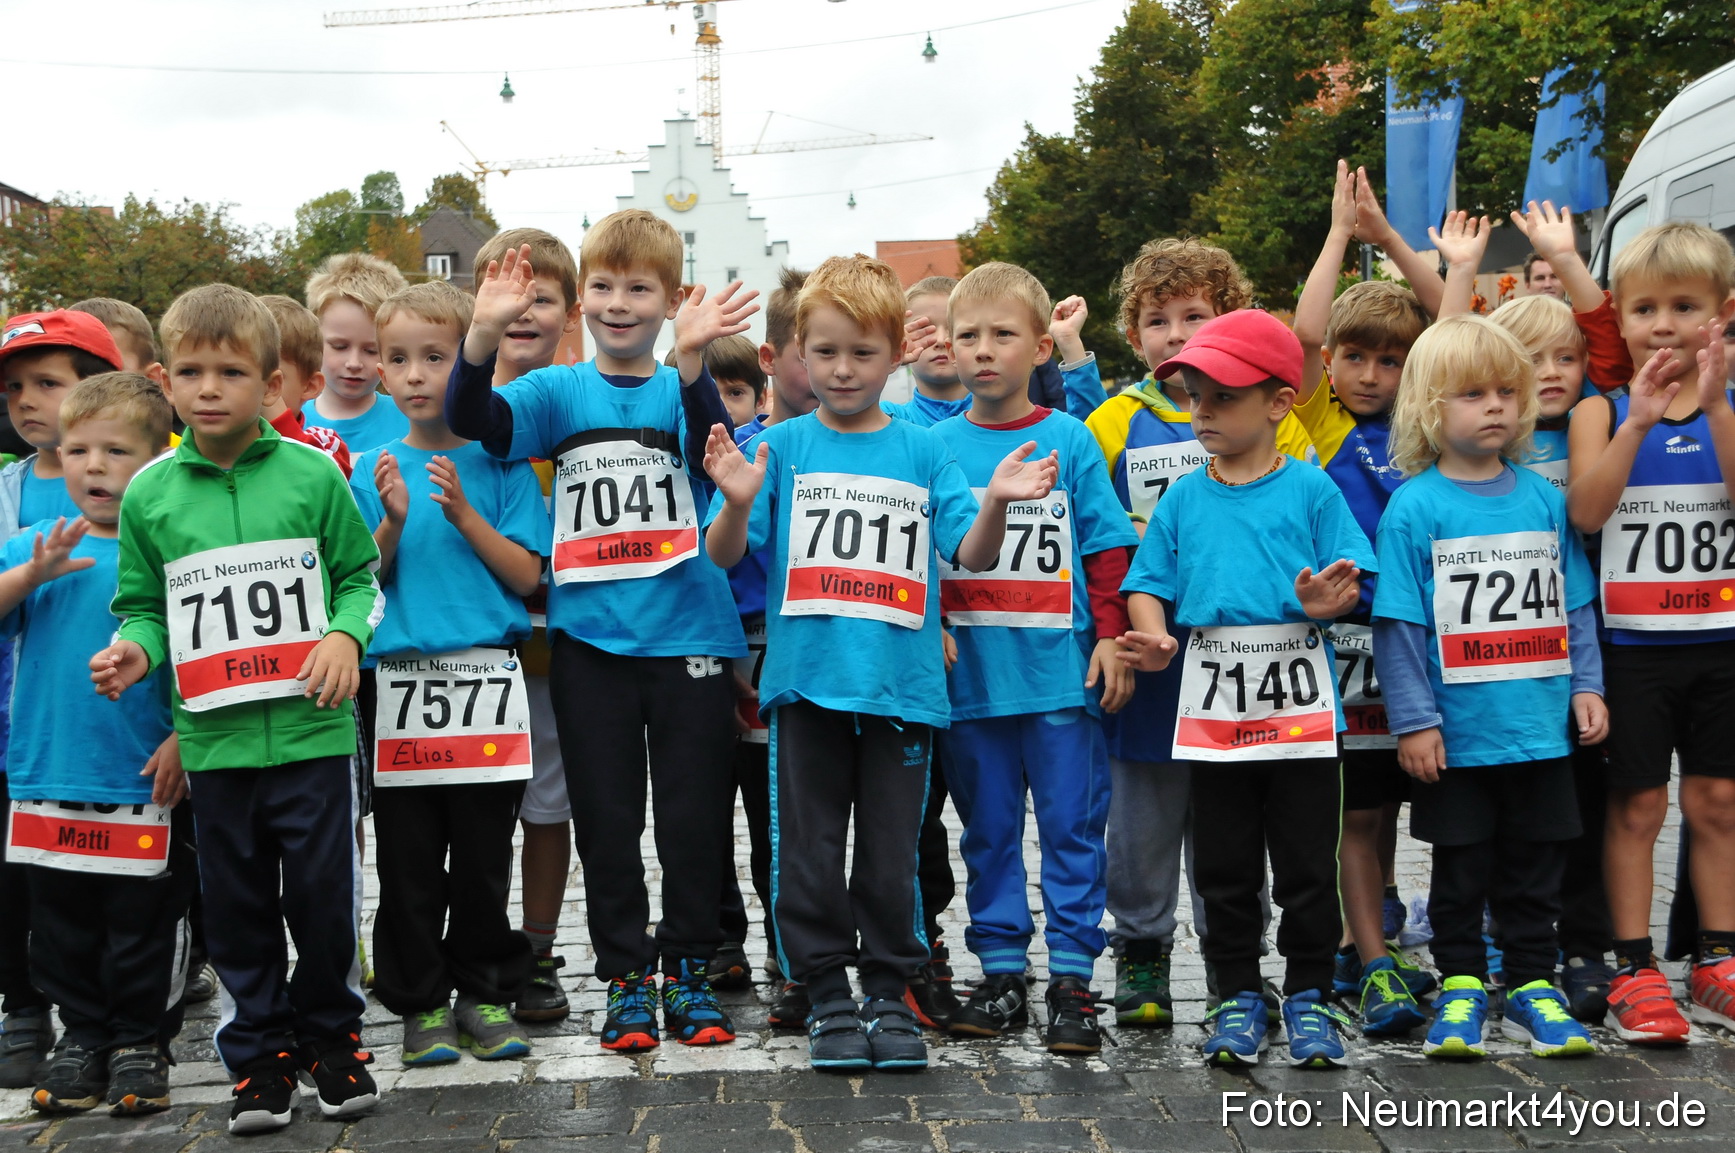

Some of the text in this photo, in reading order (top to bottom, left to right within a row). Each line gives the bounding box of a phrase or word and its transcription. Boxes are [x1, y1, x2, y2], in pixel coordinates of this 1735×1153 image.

[1666, 444, 1701, 454] skinfit
[559, 454, 666, 480] PARTL Neumarkt
[1131, 457, 1177, 474] PARTL
[566, 473, 678, 533] 7041
[797, 487, 916, 512] PARTL Neumarkt
[1615, 498, 1731, 514] ARTL Neumarkt
[597, 539, 653, 560] Lukas
[805, 508, 919, 571] 7011
[1621, 519, 1735, 574] 7082
[1438, 547, 1549, 567] PARTL Neumarkt
[169, 556, 296, 592] PARTL Neumarkt
[820, 573, 894, 601] Vincent
[1450, 567, 1560, 625] 7244
[1659, 589, 1711, 609] Joris
[181, 577, 311, 650] 7191
[1190, 638, 1301, 654] PARTL Neumarkt
[1332, 635, 1370, 650] ARTL
[1462, 635, 1560, 661] Maximilian
[225, 654, 281, 681] Felix
[380, 659, 497, 674] PARTL Neumarkt
[1201, 657, 1320, 713] 7140
[390, 677, 512, 730] 7577
[1230, 728, 1279, 747] Jona
[392, 741, 454, 765] Elias
[58, 826, 110, 850] Matti
[1221, 1001, 1238, 1009] FILA
[1311, 1004, 1330, 1013] FILA
